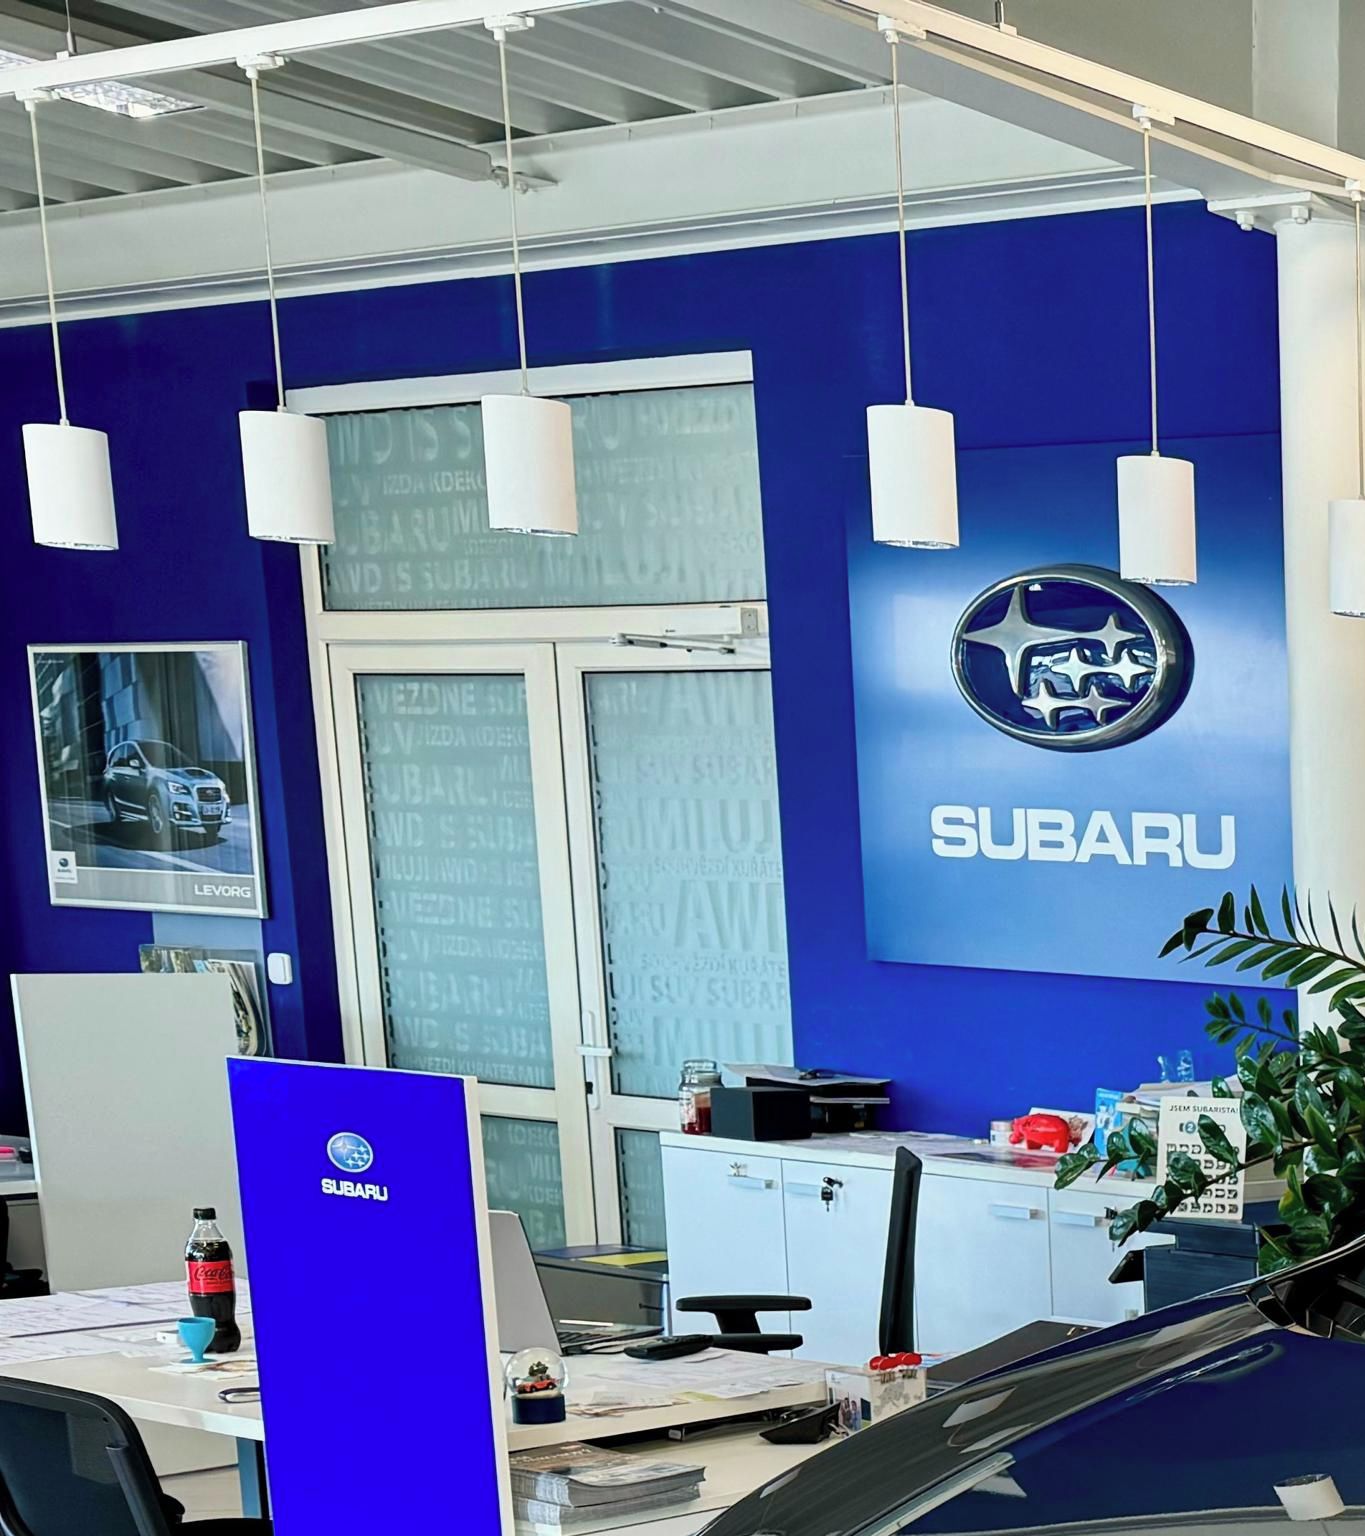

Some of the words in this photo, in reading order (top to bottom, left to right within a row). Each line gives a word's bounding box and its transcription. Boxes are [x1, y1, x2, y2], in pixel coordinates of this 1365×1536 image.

[930, 805, 1237, 871] SUBARU
[194, 884, 252, 899] LEVORG
[1193, 1106, 1239, 1114] SUBARISTA!
[320, 1177, 389, 1202] SUBARU
